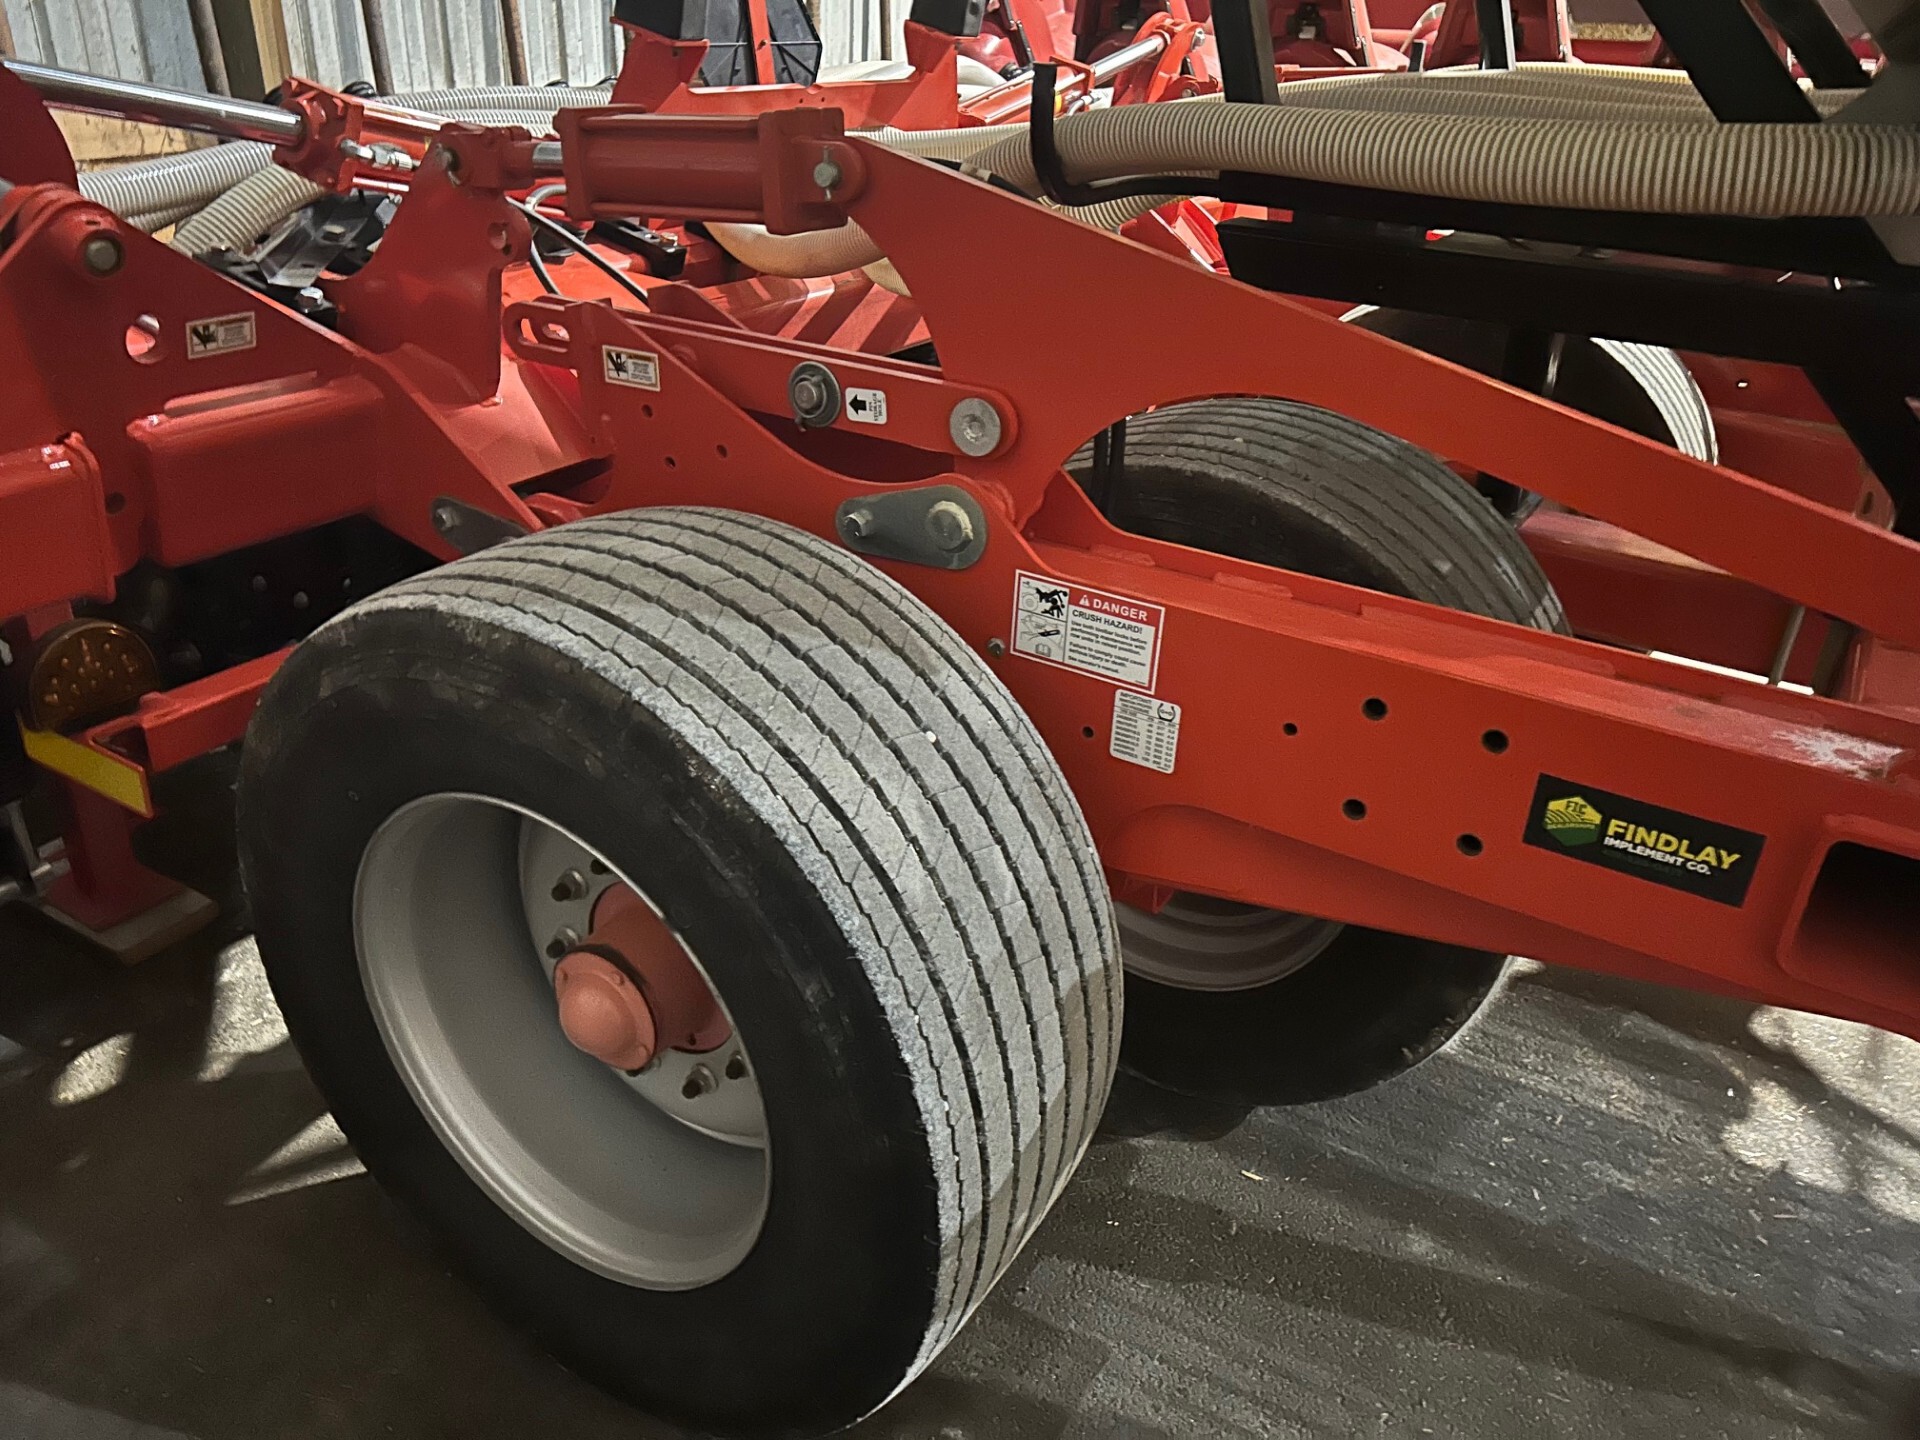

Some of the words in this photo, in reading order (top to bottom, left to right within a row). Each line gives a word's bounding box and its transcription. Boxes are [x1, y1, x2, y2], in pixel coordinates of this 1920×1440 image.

[1073, 610, 1102, 623] CRUSH
[1104, 618, 1142, 634] HAZARD!
[1093, 599, 1148, 621] DANGER
[1565, 799, 1588, 815] FIC
[1607, 818, 1741, 870] FINDLAY
[1603, 837, 1686, 867] IMPLEMENT
[1685, 860, 1712, 876] CO.
